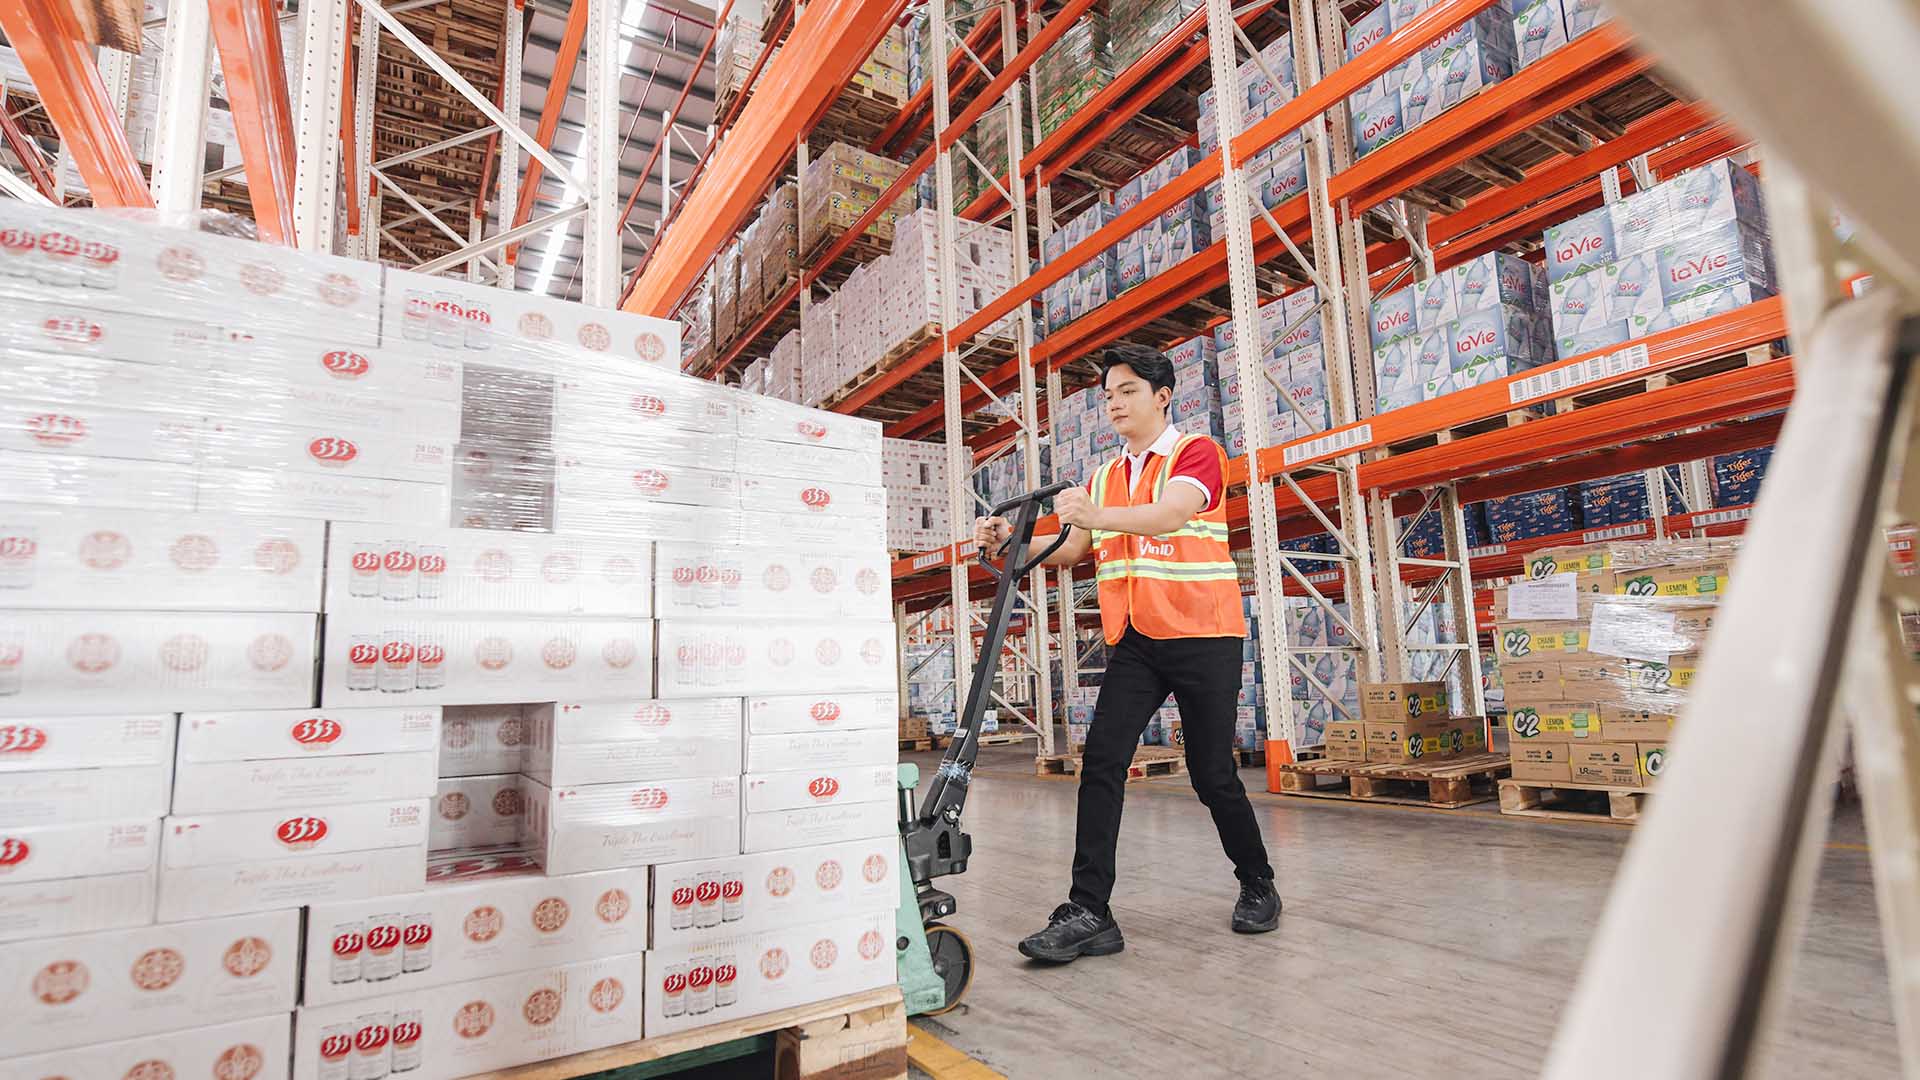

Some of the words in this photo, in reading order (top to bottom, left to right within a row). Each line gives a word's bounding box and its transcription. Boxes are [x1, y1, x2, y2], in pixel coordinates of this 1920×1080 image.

[323, 352, 368, 374] 333
[309, 438, 357, 461] 333
[1727, 458, 1752, 471] Tiger
[1730, 469, 1755, 483] Tiger
[802, 488, 831, 506] 333
[353, 552, 381, 570] 333
[384, 551, 415, 571] 333
[419, 555, 445, 572] 333
[1531, 561, 1558, 580] C2
[1666, 584, 1687, 593] LEMON
[351, 645, 379, 663] 333
[383, 641, 414, 663] 333
[1504, 631, 1531, 657] C2
[812, 702, 840, 720] 333
[1407, 694, 1422, 717] C2
[293, 719, 341, 743] 333
[1513, 711, 1541, 738] C2
[1545, 718, 1565, 726] LEMON
[1408, 734, 1424, 757] C2
[1451, 731, 1464, 750] C2
[808, 778, 839, 797] 333
[277, 817, 327, 843] 333
[672, 887, 694, 905] 333
[696, 881, 721, 902] 333
[723, 881, 743, 897] 333
[333, 934, 363, 955] 333
[367, 926, 400, 949] 333
[404, 925, 432, 944] 333
[664, 974, 686, 993] 333
[689, 966, 713, 988] 333
[715, 965, 736, 983] 333
[321, 1035, 352, 1058] 333
[355, 1026, 389, 1050] 333
[393, 1023, 422, 1044] 333
